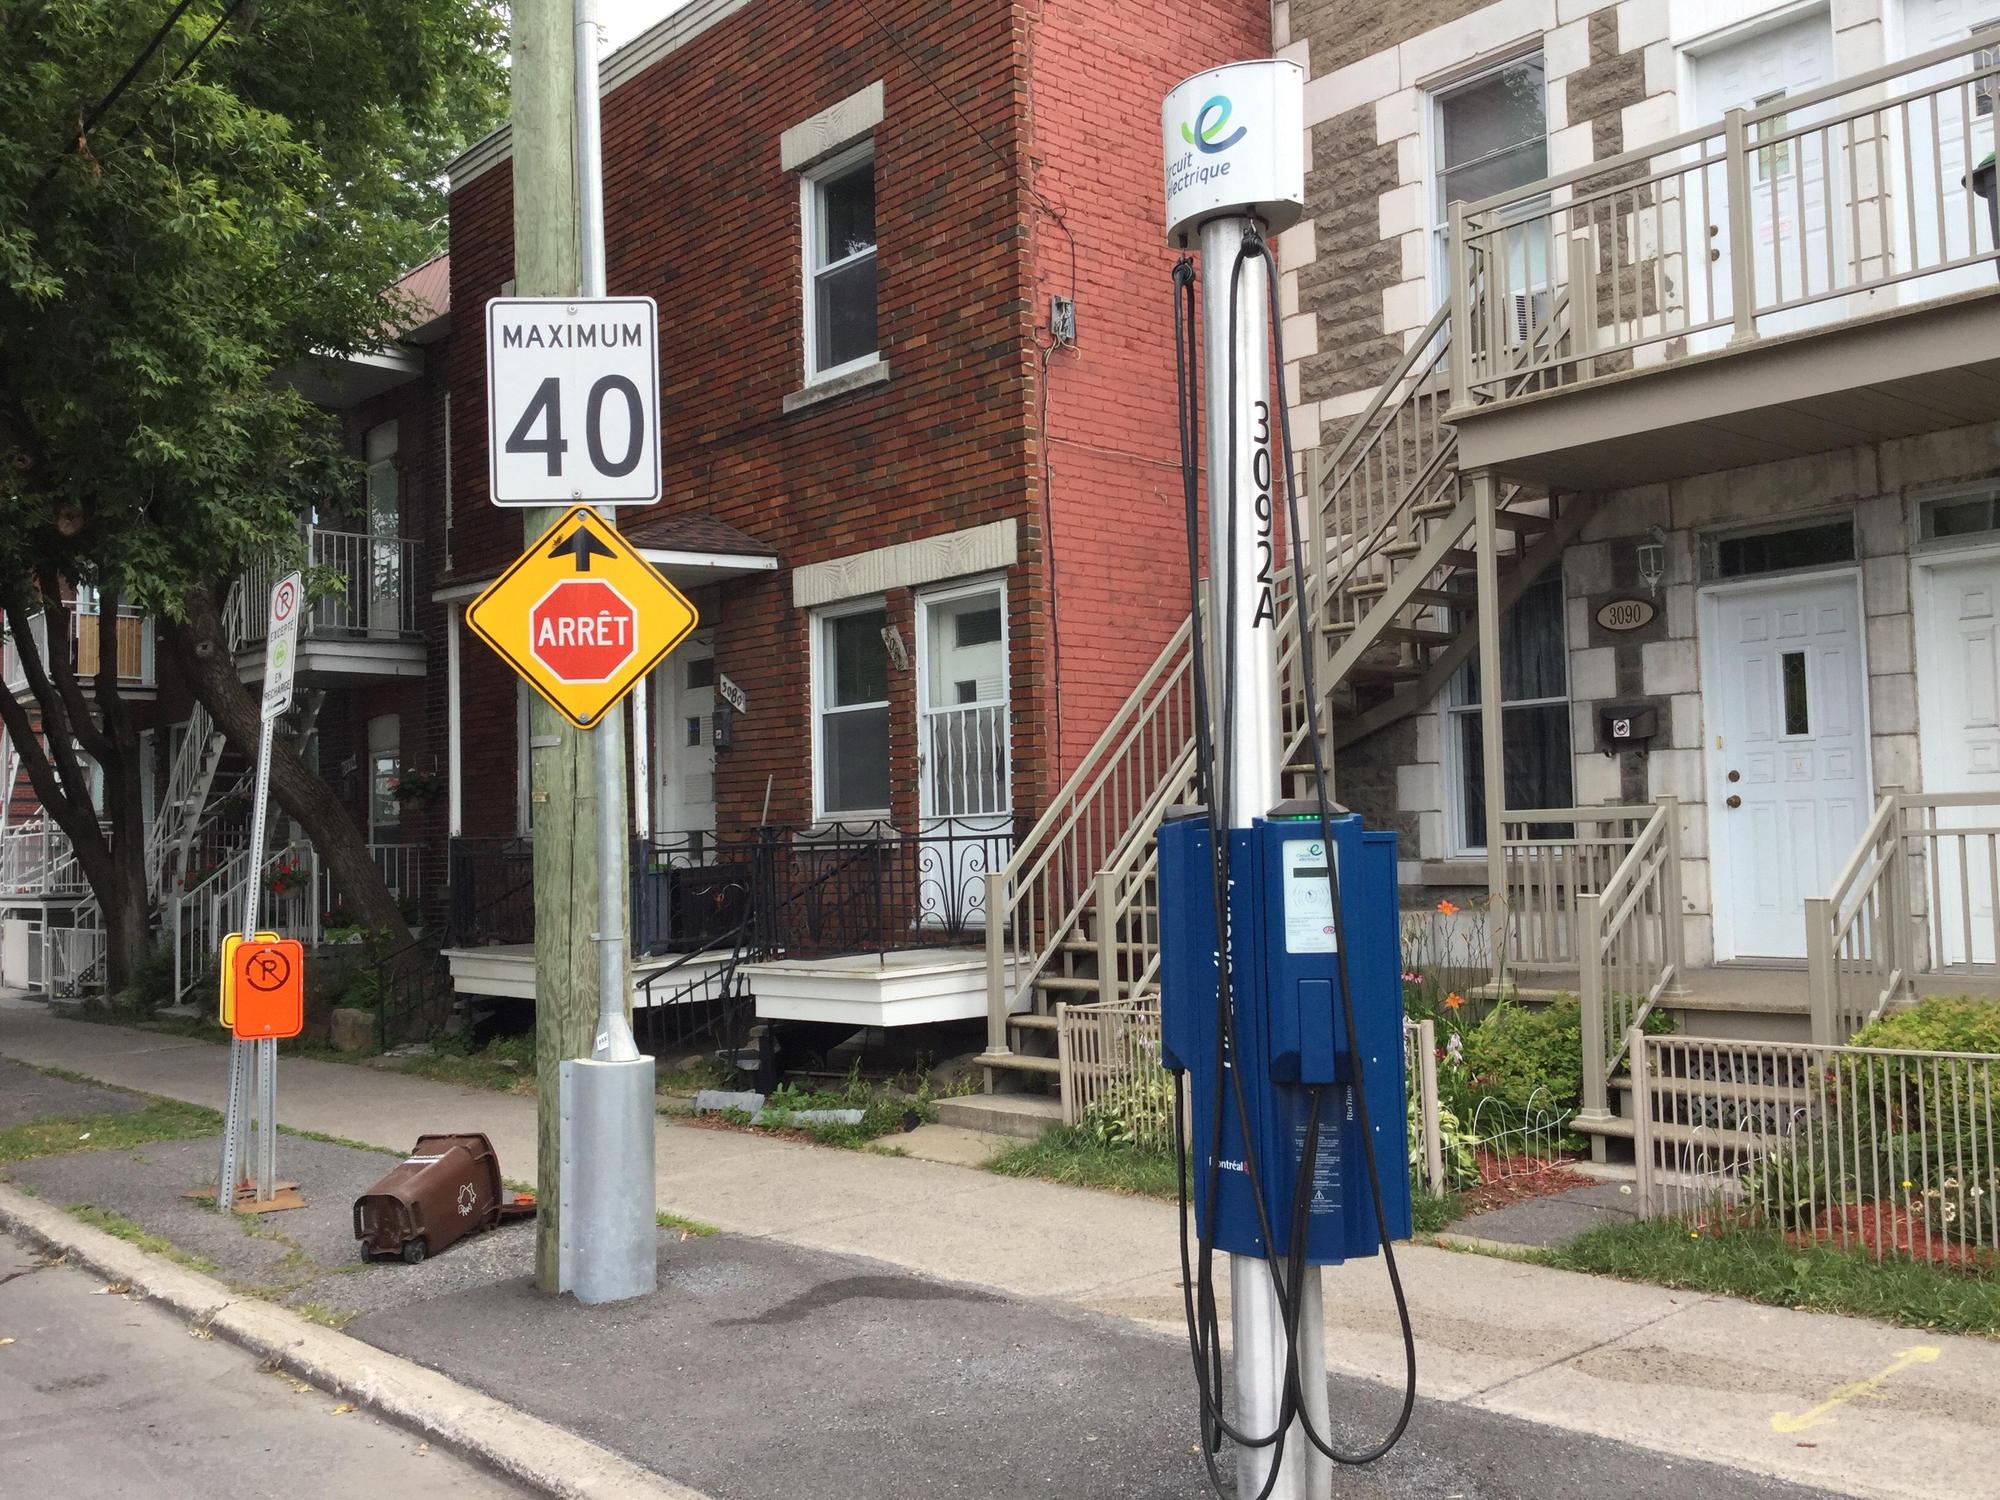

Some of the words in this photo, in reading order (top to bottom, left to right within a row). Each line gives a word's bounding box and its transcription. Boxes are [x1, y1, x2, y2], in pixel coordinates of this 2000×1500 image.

[503, 323, 642, 349] MAXIMUM
[505, 374, 644, 477] 40
[1252, 400, 1276, 630] 3092A
[537, 610, 629, 647] ARRÊT
[1610, 603, 1641, 626] 3090
